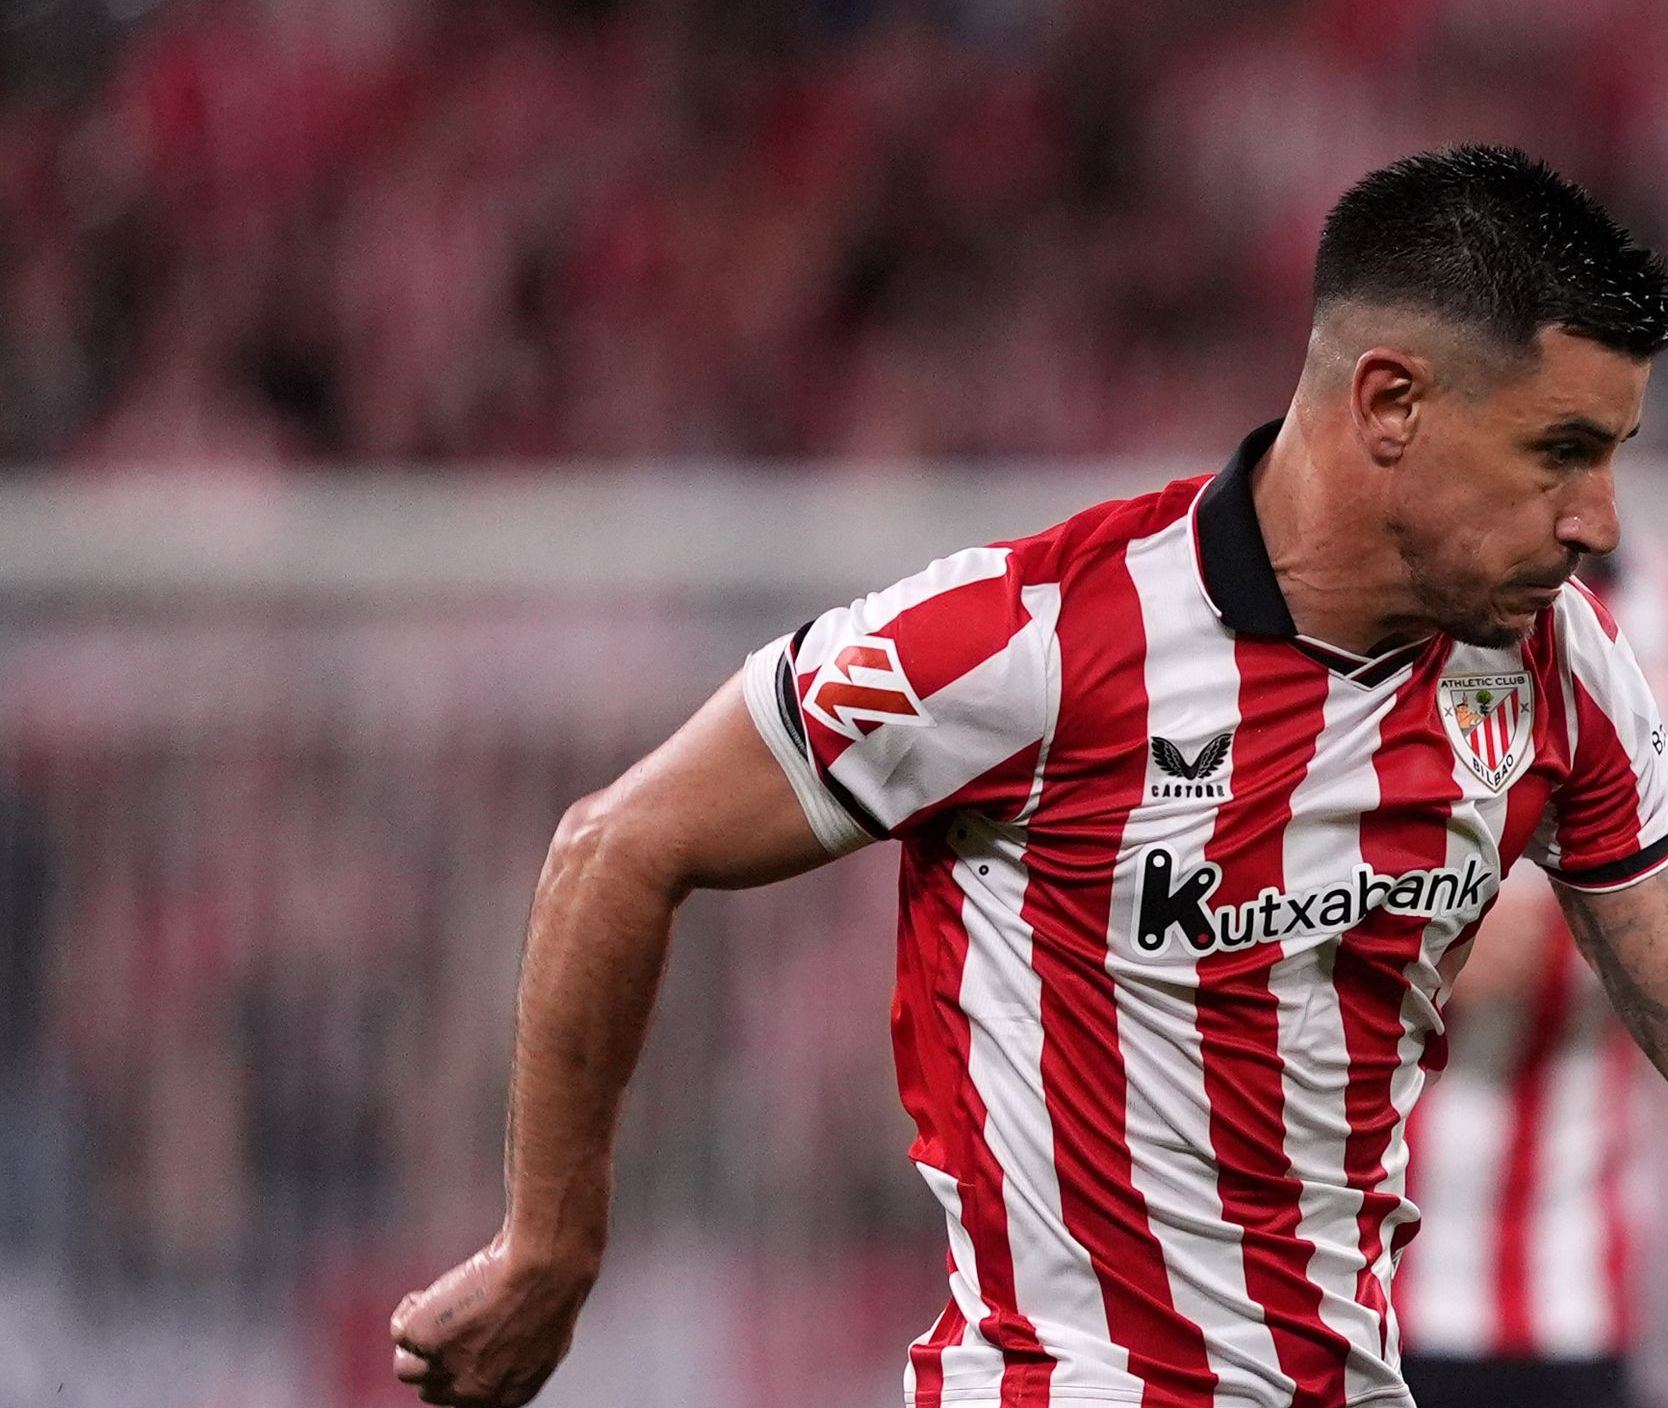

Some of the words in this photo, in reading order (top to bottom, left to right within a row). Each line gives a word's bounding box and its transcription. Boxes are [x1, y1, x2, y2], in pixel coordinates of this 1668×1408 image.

[1440, 677, 1493, 689] ATHLETIC
[1495, 676, 1526, 686] CLUB
[1472, 753, 1514, 787] BILBAO
[1151, 784, 1225, 798] CASTORE
[1136, 846, 1493, 952] Kutxabank
